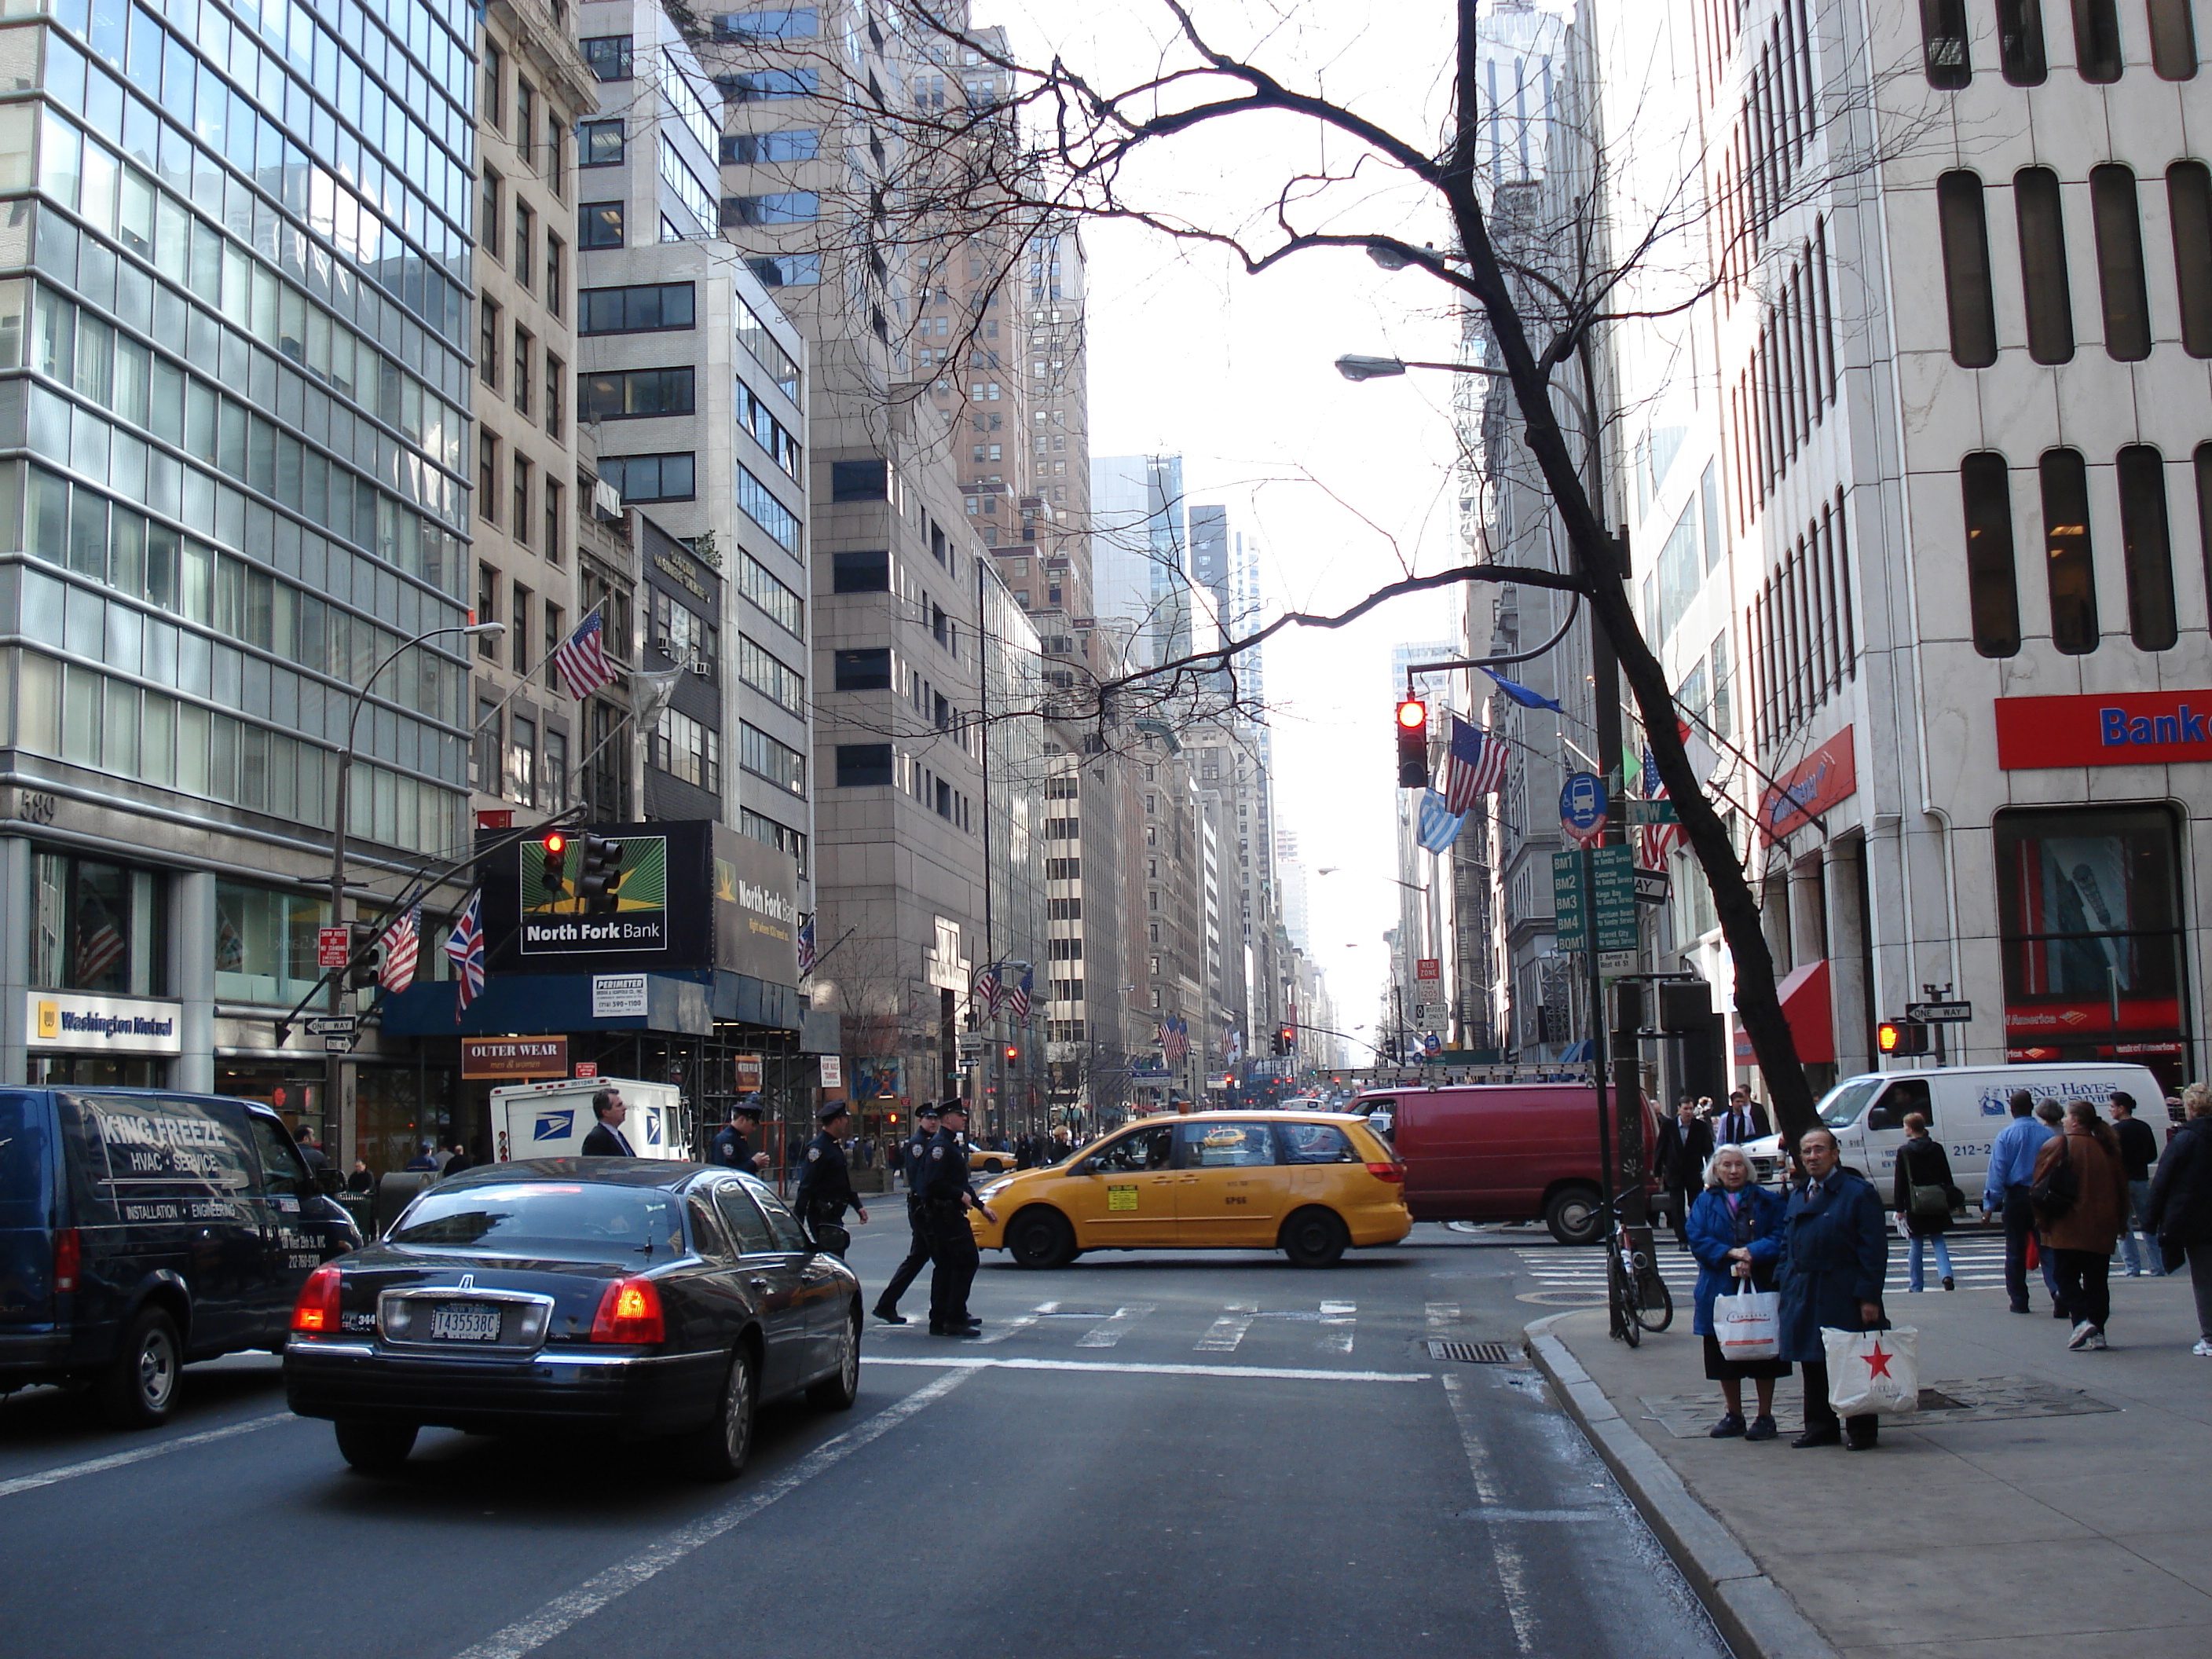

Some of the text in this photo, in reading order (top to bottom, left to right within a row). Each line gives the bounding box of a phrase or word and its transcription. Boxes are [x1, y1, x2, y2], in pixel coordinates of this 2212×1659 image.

[2100, 705, 2206, 745] Bank
[20, 790, 54, 826] 589
[1647, 803, 1661, 821] W
[1555, 855, 1573, 870] BM1
[1555, 875, 1576, 890] BM2
[1635, 879, 1653, 892] AY
[738, 880, 763, 914] North
[764, 890, 782, 920] Fork
[1556, 895, 1577, 910] BM3
[1558, 914, 1579, 930] BM4
[527, 922, 660, 941] North Fork Bank
[1558, 934, 1584, 950] BQM1
[598, 980, 643, 988] PERIMETER
[1943, 1008, 1961, 1016] WAY
[2012, 1014, 2056, 1025] America
[61, 1011, 172, 1038] Washington Mutual
[471, 1044, 557, 1057] OUTER WEAR
[2008, 1049, 2023, 1058] rica
[100, 1115, 226, 1147] KING FREEZE
[131, 1152, 218, 1171] HVAC SERVICE
[126, 1203, 235, 1219] INSTALLATION ENGINEERING
[358, 1314, 375, 1325] 344
[438, 1313, 494, 1331] T435538C
